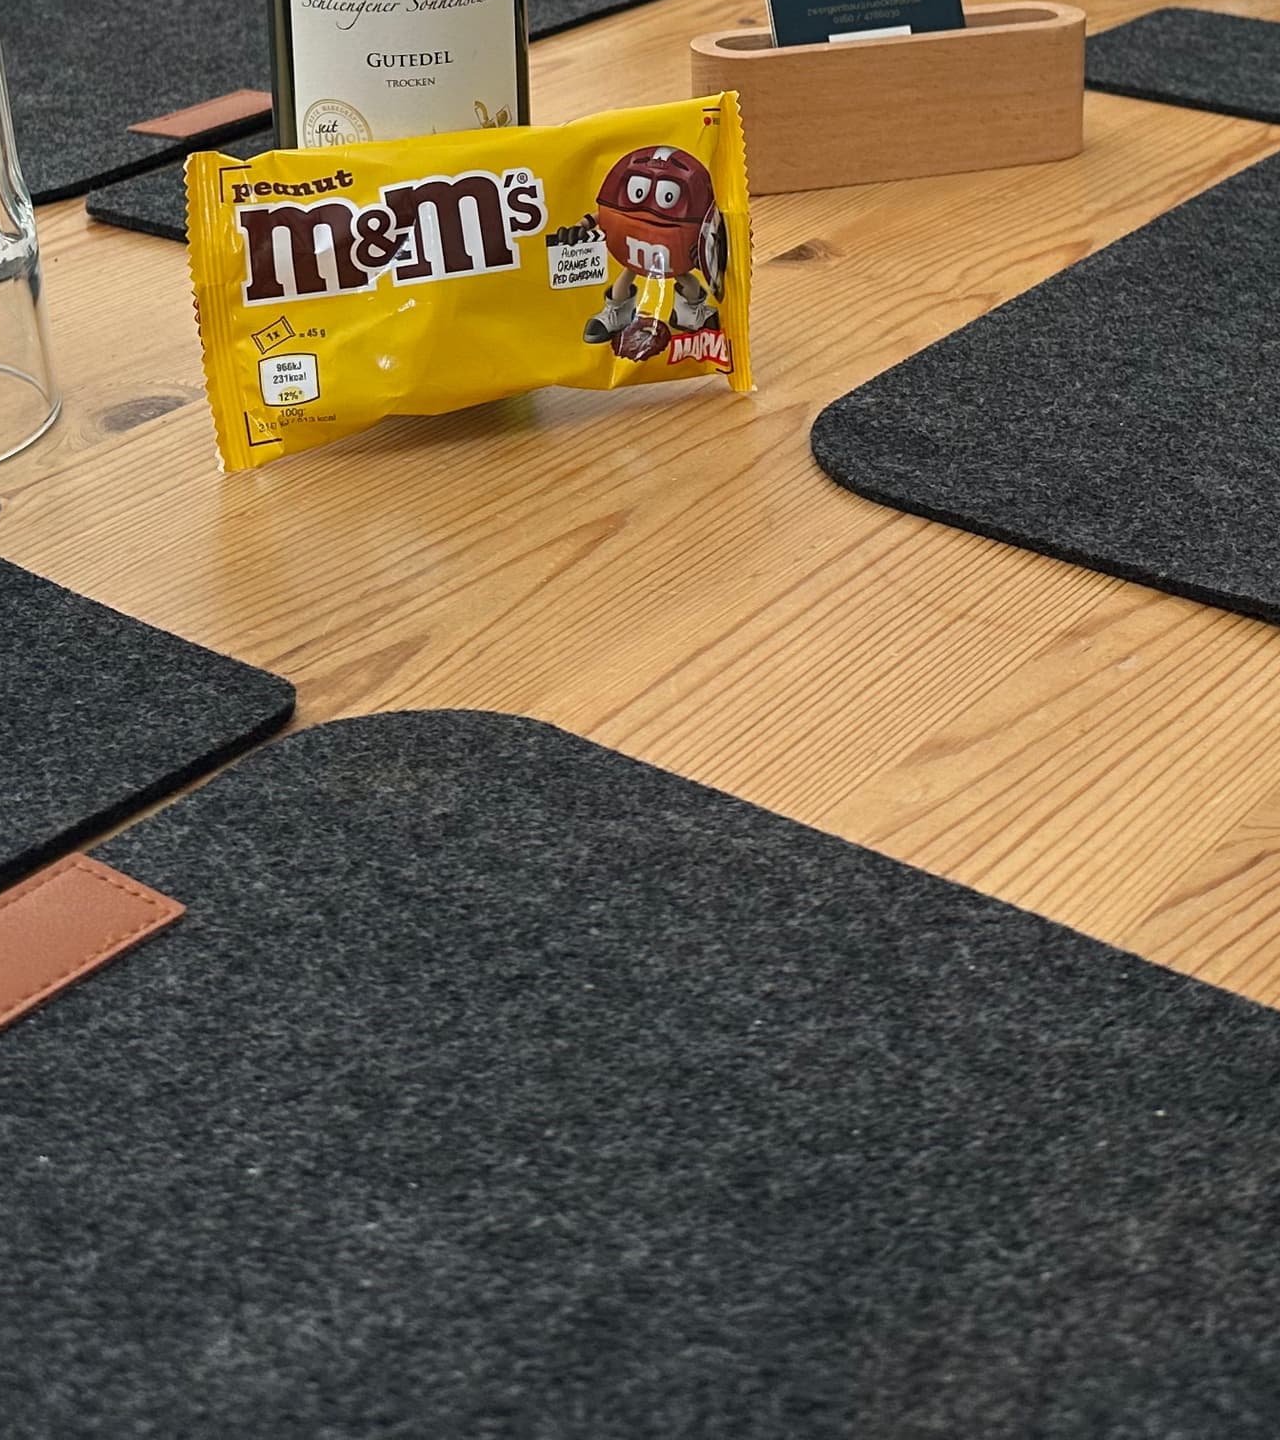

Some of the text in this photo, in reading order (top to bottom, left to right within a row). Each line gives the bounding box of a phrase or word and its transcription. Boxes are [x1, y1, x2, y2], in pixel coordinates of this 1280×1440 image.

[386, 77, 436, 89] TROCKEN
[315, 119, 339, 135] seit
[231, 168, 354, 203] peanut
[557, 256, 601, 272] ORANGE AS
[553, 272, 568, 286] RED
[307, 328, 319, 337] 45
[671, 329, 729, 363] MARVE
